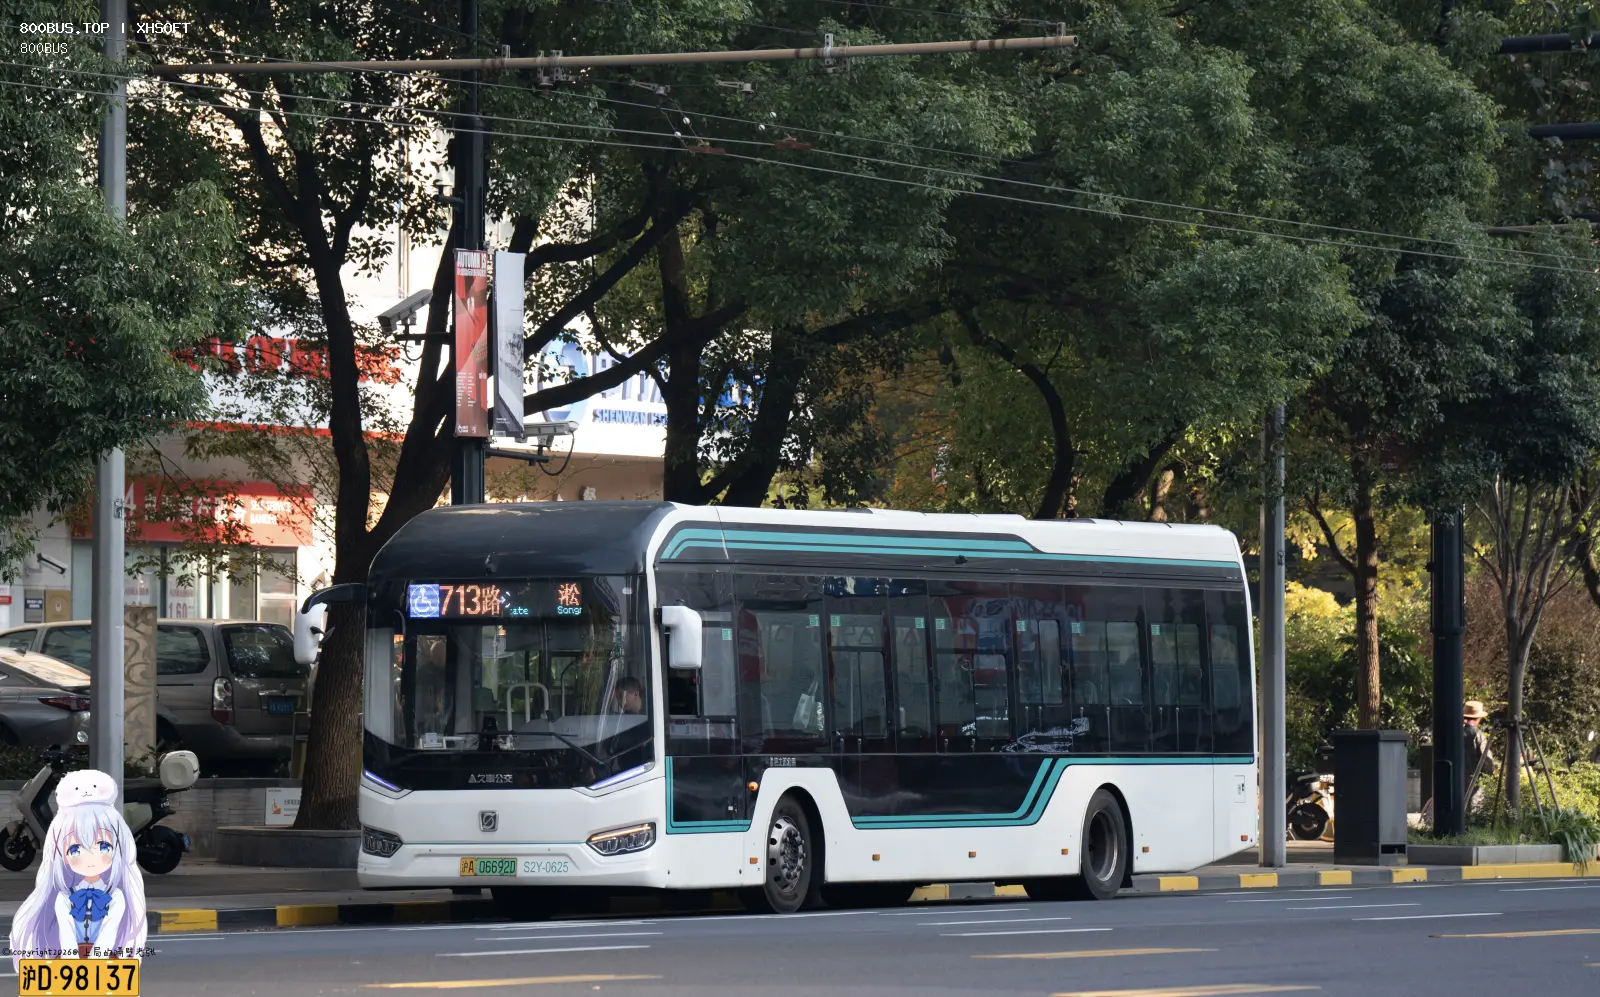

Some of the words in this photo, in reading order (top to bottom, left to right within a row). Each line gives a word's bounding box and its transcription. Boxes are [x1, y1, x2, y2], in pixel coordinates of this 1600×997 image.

[592, 408, 647, 426] SHENWAN
[439, 584, 500, 616] 713路
[523, 861, 569, 873] S2Y-0625
